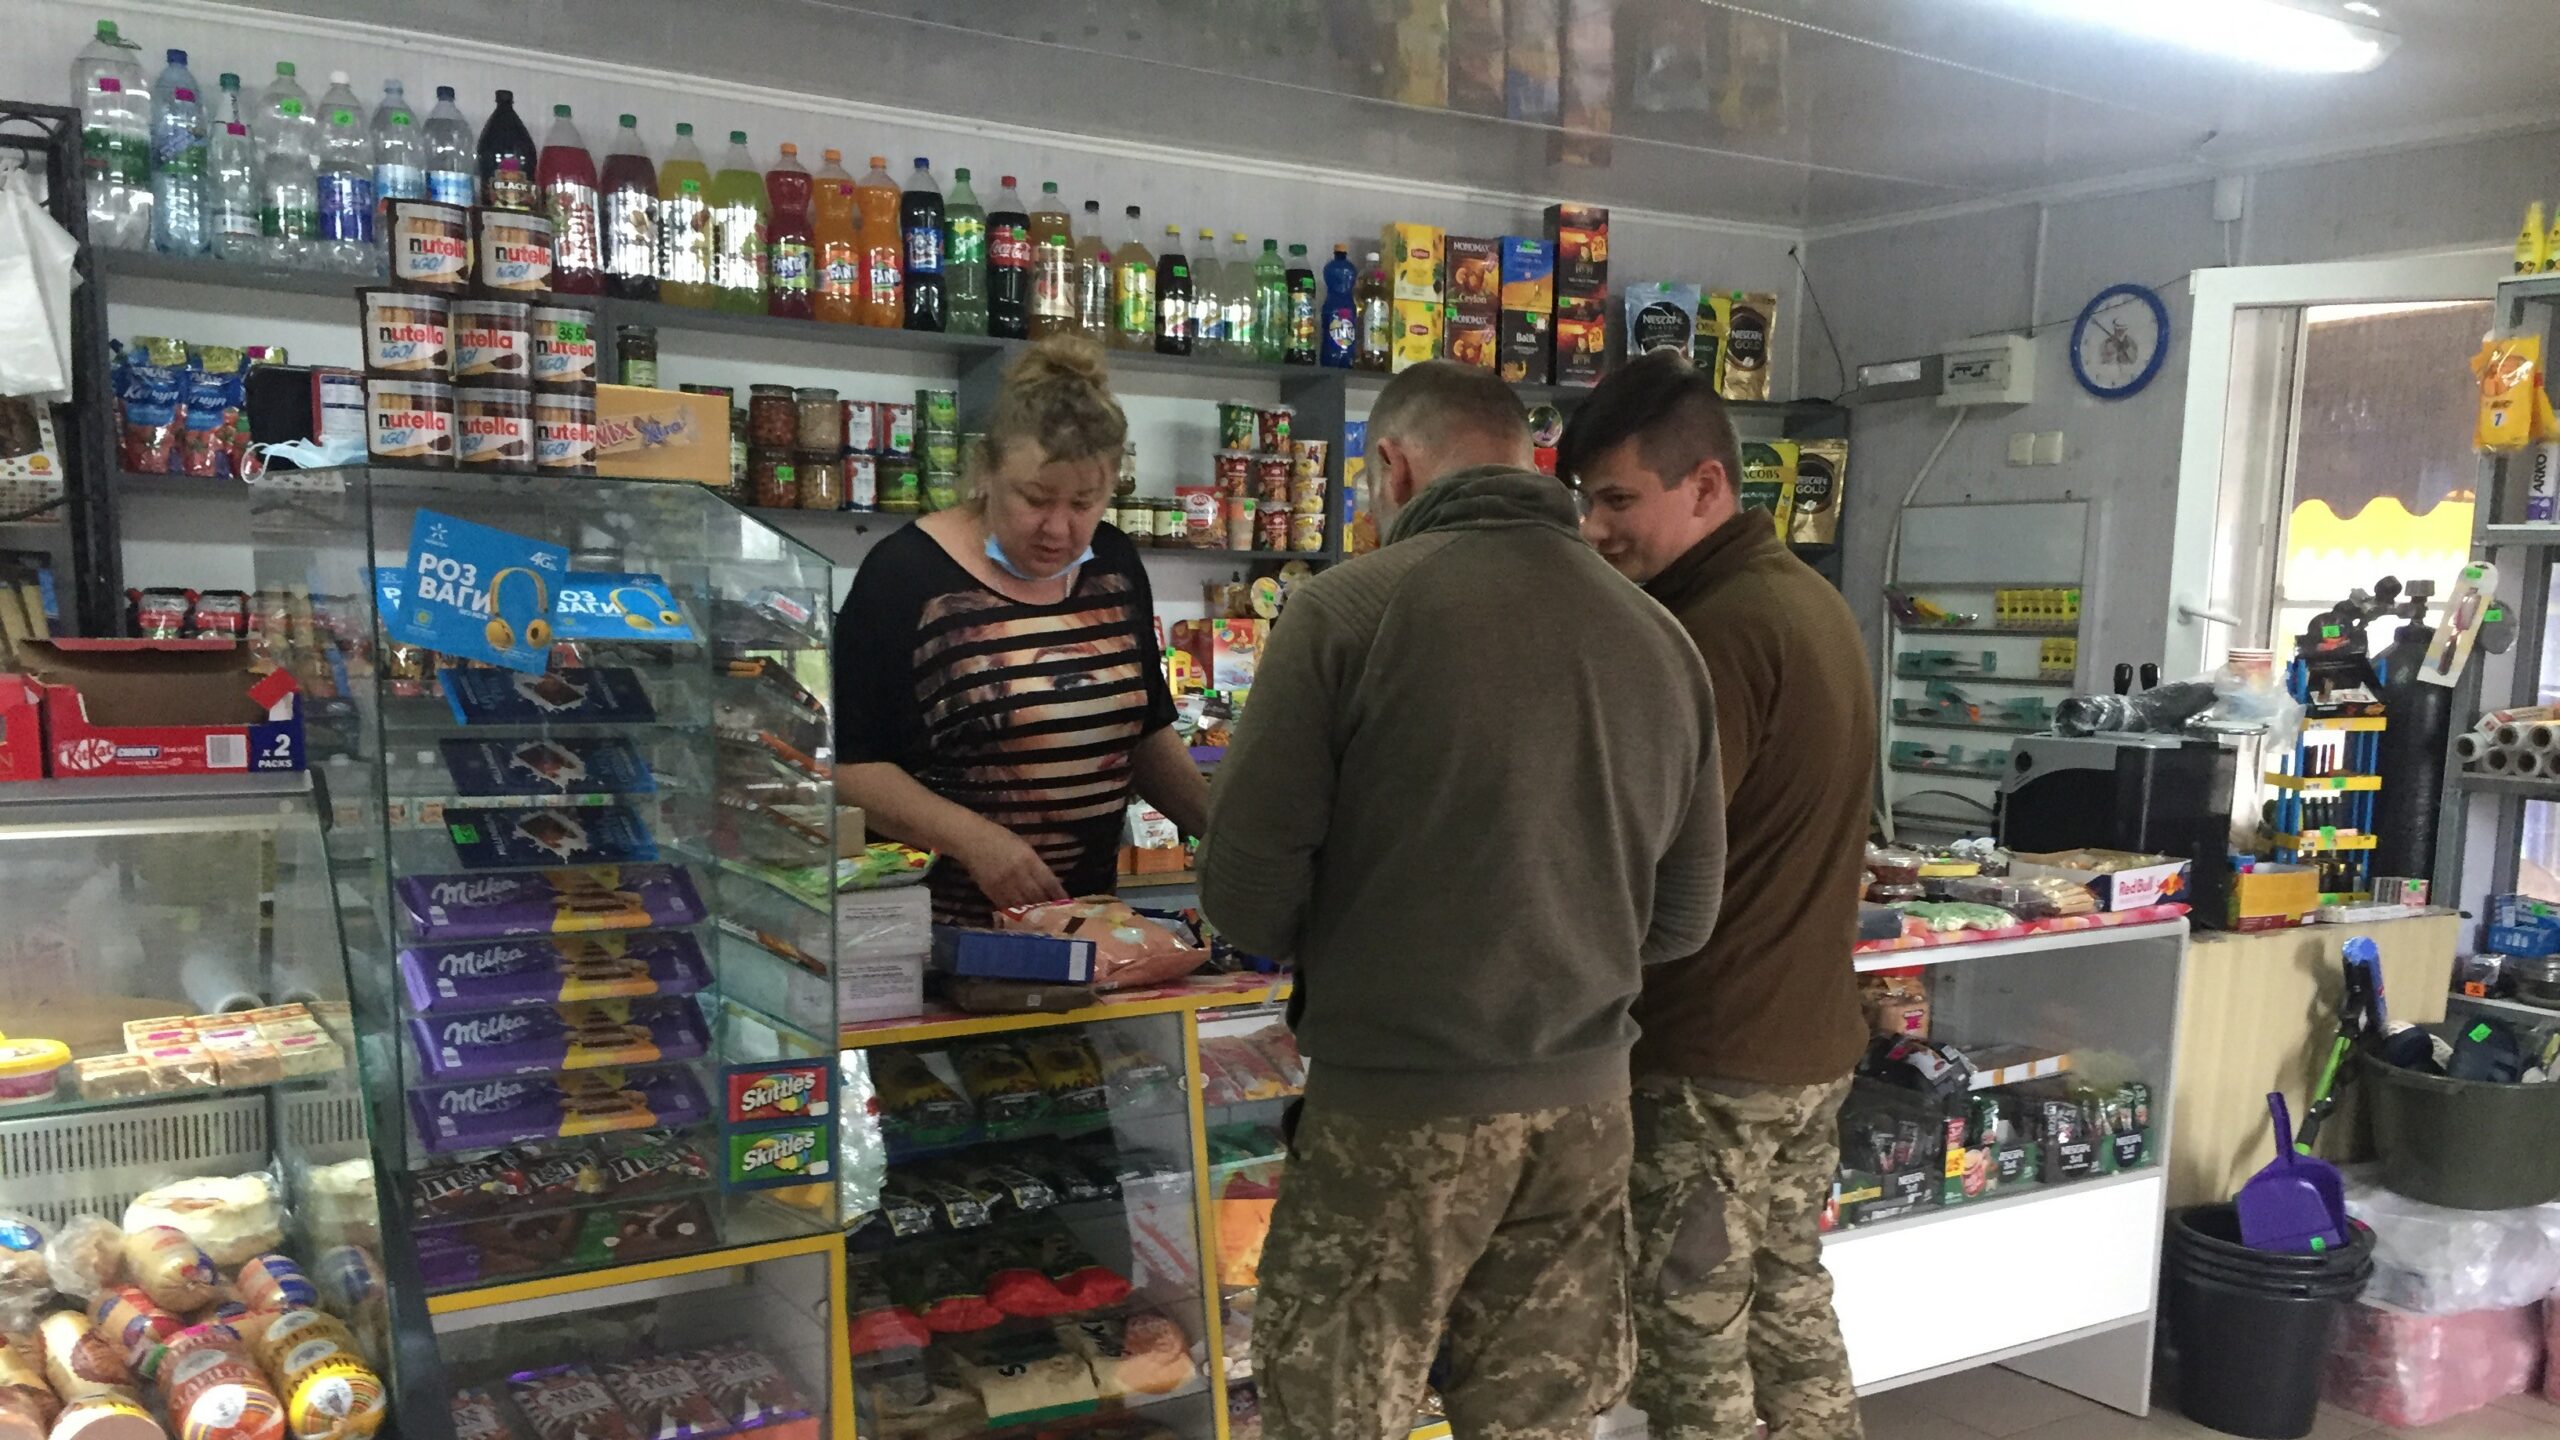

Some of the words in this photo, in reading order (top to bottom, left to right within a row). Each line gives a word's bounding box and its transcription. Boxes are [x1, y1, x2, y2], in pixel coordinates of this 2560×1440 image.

[379, 325, 444, 345] nutella
[379, 411, 446, 431] nutella
[2533, 453, 2548, 494] ARKO
[1796, 485, 1826, 494] GOLD
[418, 552, 477, 586] РОЗ
[418, 576, 492, 615] ВАГИ
[559, 590, 597, 602] ОЗ
[274, 734, 291, 757] 2
[258, 759, 293, 768] PACKS
[432, 877, 519, 905] Milka
[438, 946, 527, 977] Milka
[443, 1014, 530, 1046] Milka
[440, 1081, 525, 1115] Milka
[741, 1072, 816, 1111] Skittles
[741, 1131, 815, 1171] Skittles
